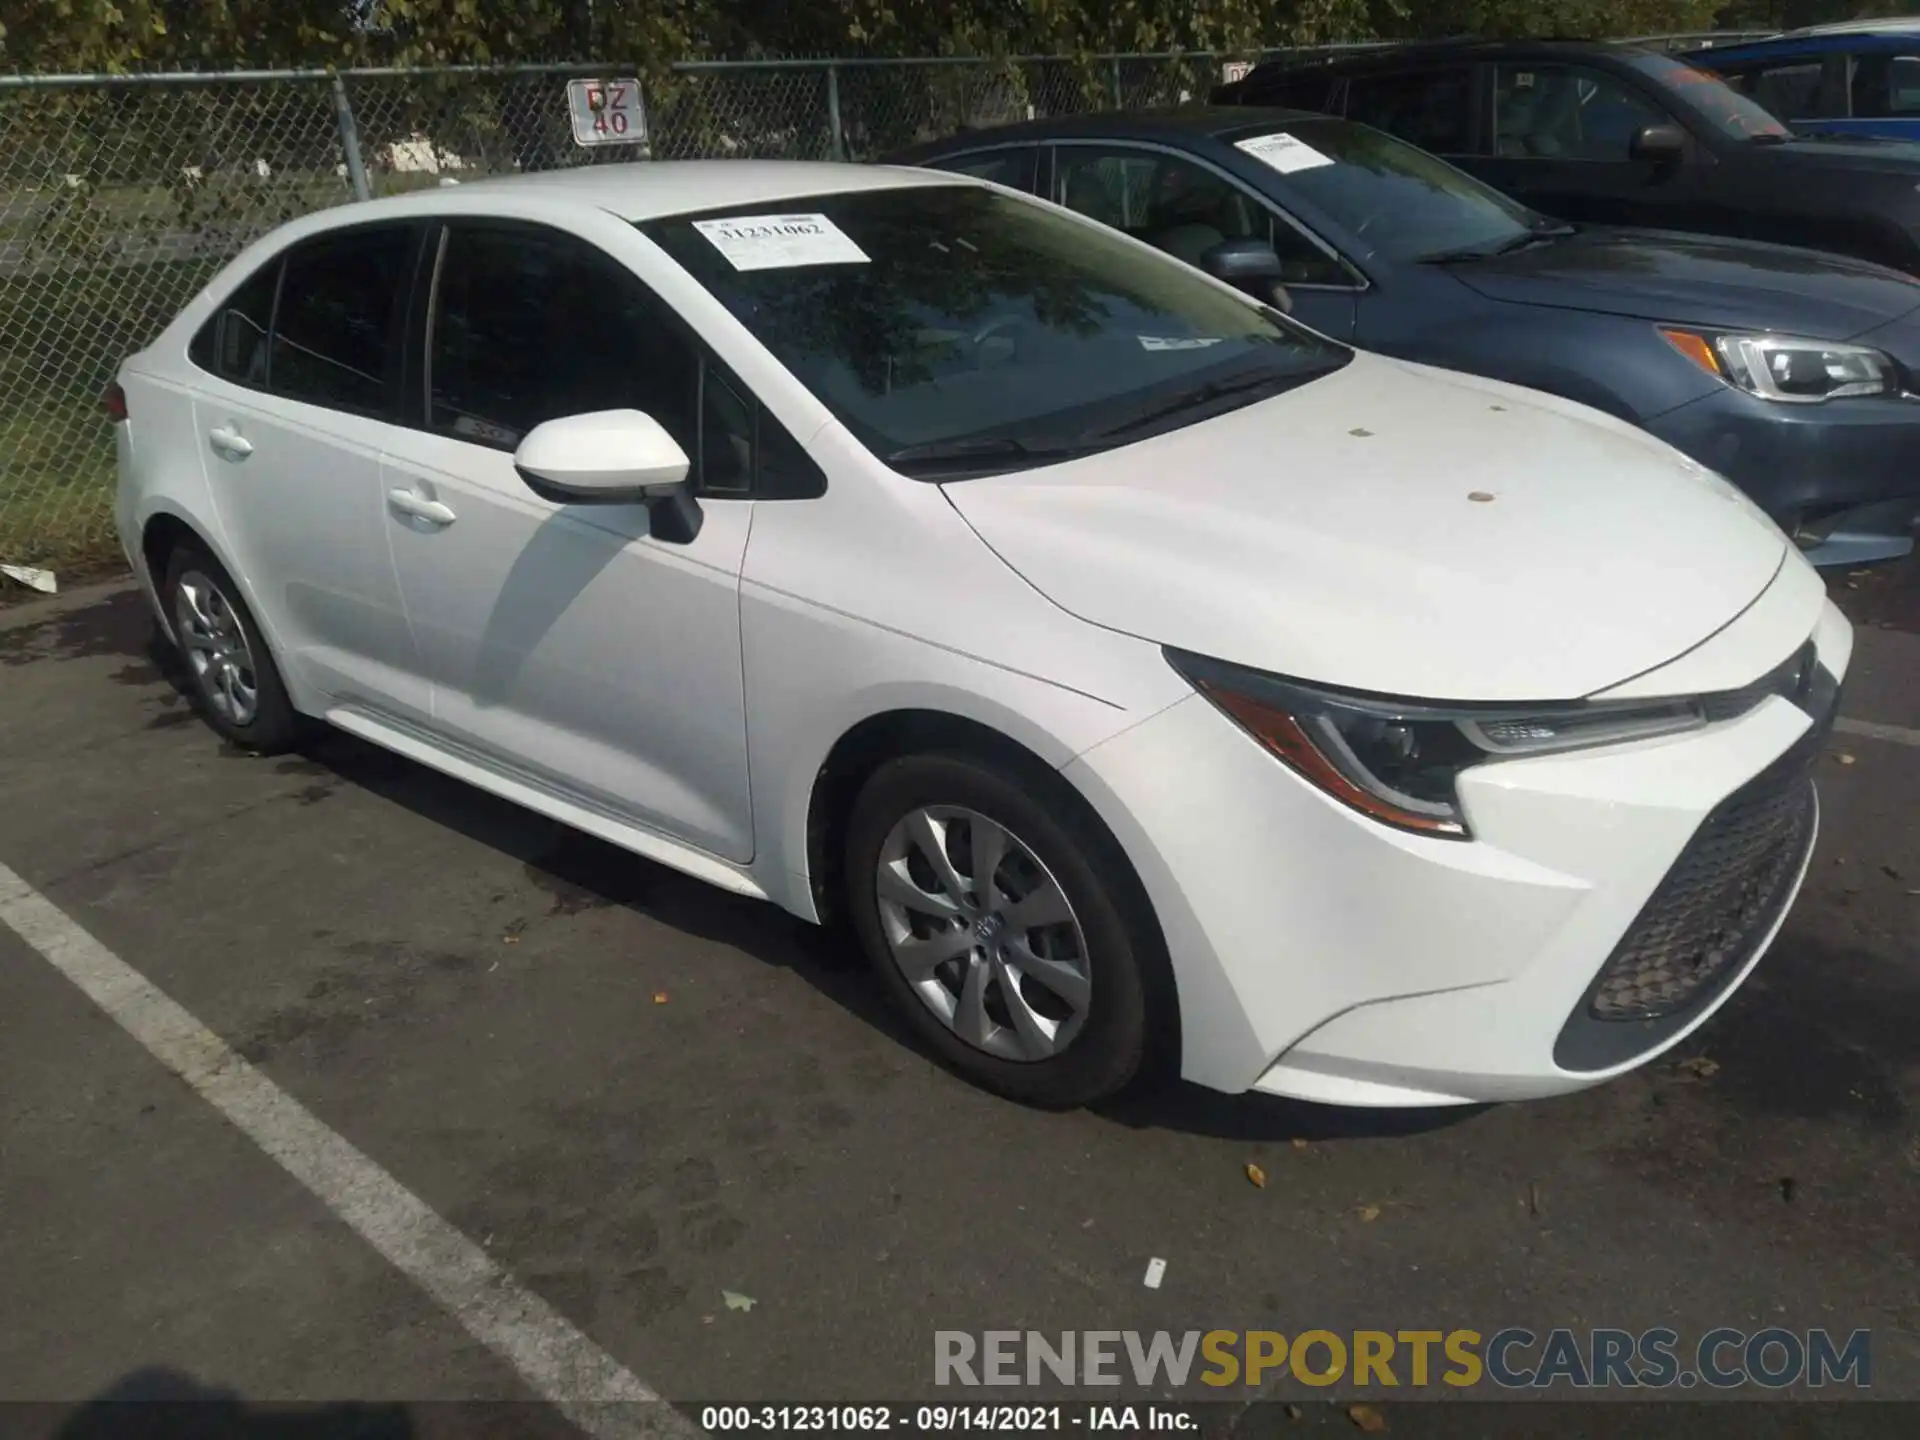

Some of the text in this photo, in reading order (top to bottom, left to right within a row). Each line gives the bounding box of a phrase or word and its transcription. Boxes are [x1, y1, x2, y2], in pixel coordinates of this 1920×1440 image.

[586, 86, 628, 112] DZ
[593, 111, 628, 135] 40
[718, 223, 825, 241] 31231062
